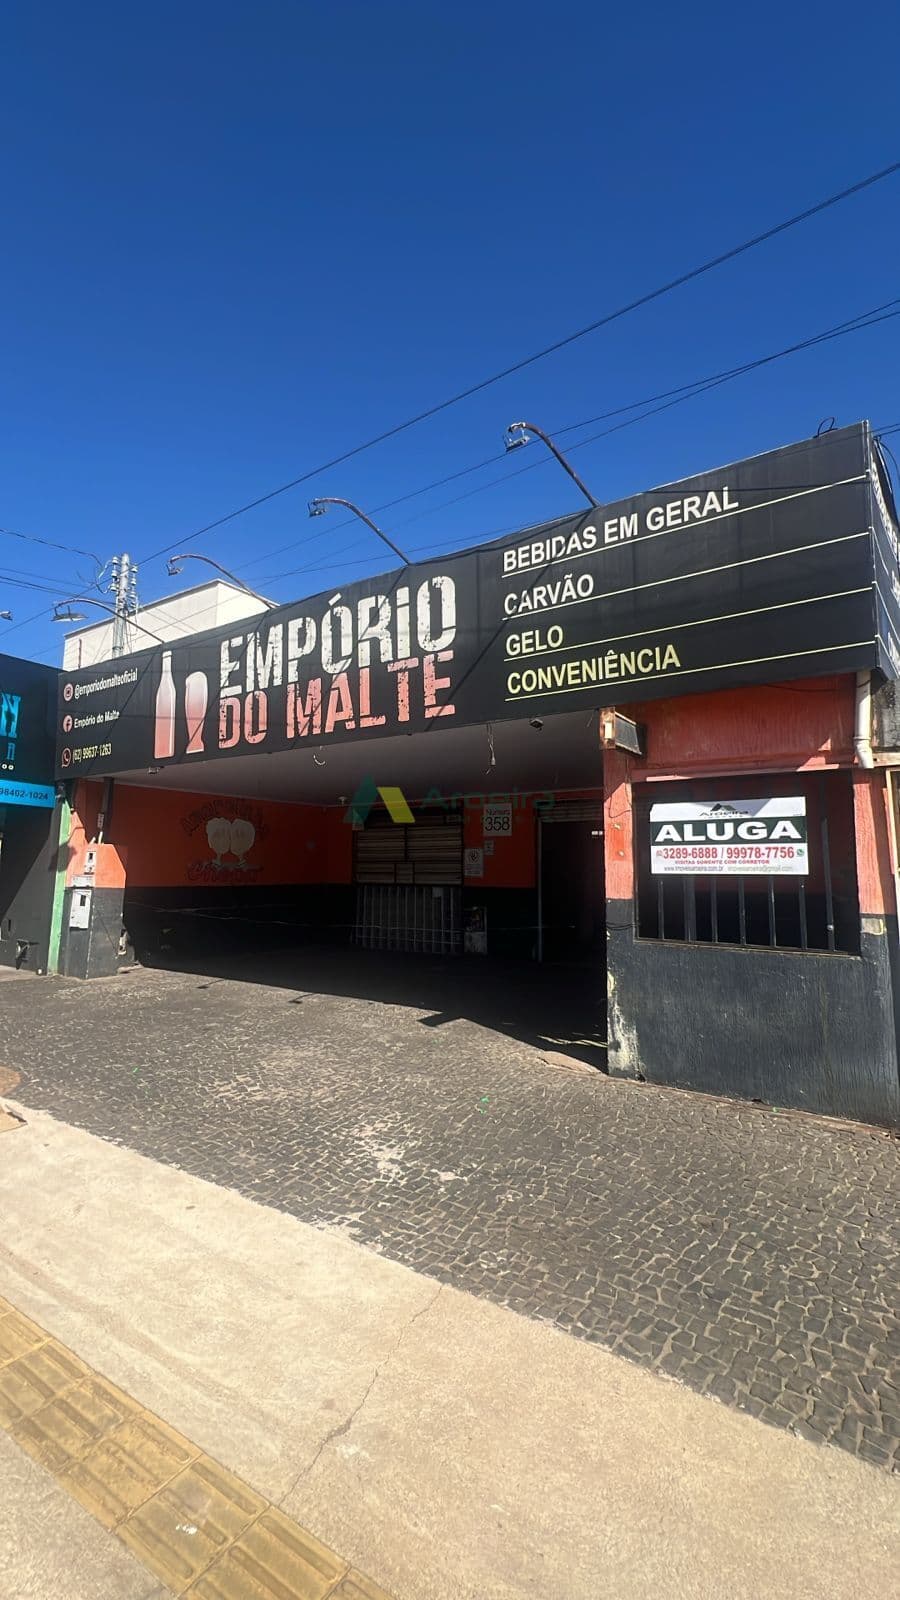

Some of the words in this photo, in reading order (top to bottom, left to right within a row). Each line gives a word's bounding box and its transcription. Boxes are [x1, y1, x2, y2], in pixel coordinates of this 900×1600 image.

[503, 525, 597, 573] BEBIDAS
[604, 512, 638, 545] EM
[646, 486, 739, 532] GERAL
[504, 573, 594, 616] CARVÃO
[219, 575, 457, 698] EMPÓRIO
[505, 625, 564, 656] GELO
[74, 668, 138, 699] @emporiodomalteoficial
[507, 644, 681, 695] CONVENIÊNCIA
[218, 690, 268, 749] DO
[286, 649, 456, 739] MALTE
[74, 714, 95, 729] Empório
[96, 713, 103, 723] do
[104, 709, 120, 722] Malte
[72, 747, 82, 763] (62)
[82, 743, 112, 760] 99637-1263
[484, 816, 510, 832] 358
[655, 820, 802, 842] ALUGA
[663, 846, 718, 859] 3289-6888
[726, 846, 795, 859] 99978-7756
